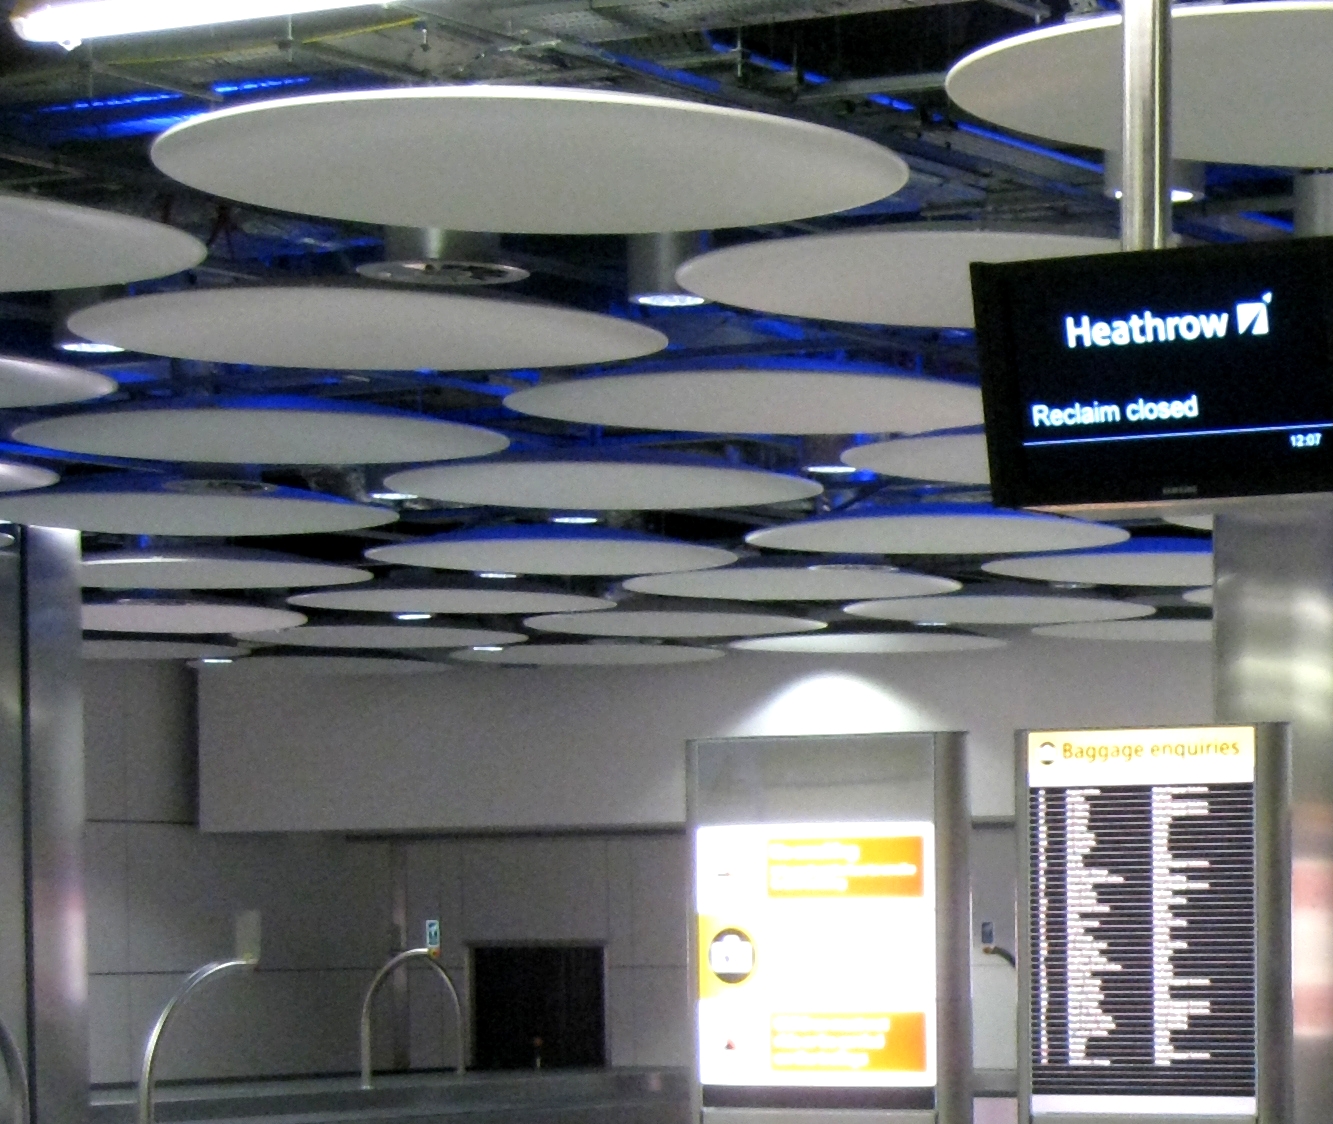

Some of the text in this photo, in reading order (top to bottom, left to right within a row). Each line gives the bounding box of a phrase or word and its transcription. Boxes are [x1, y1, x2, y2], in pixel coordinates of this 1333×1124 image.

[1065, 310, 1229, 349] Heathrow
[1032, 394, 1199, 427] Reclaim closed
[1290, 432, 1322, 447] 12:07
[1062, 740, 1240, 763] Baggage enquiries
